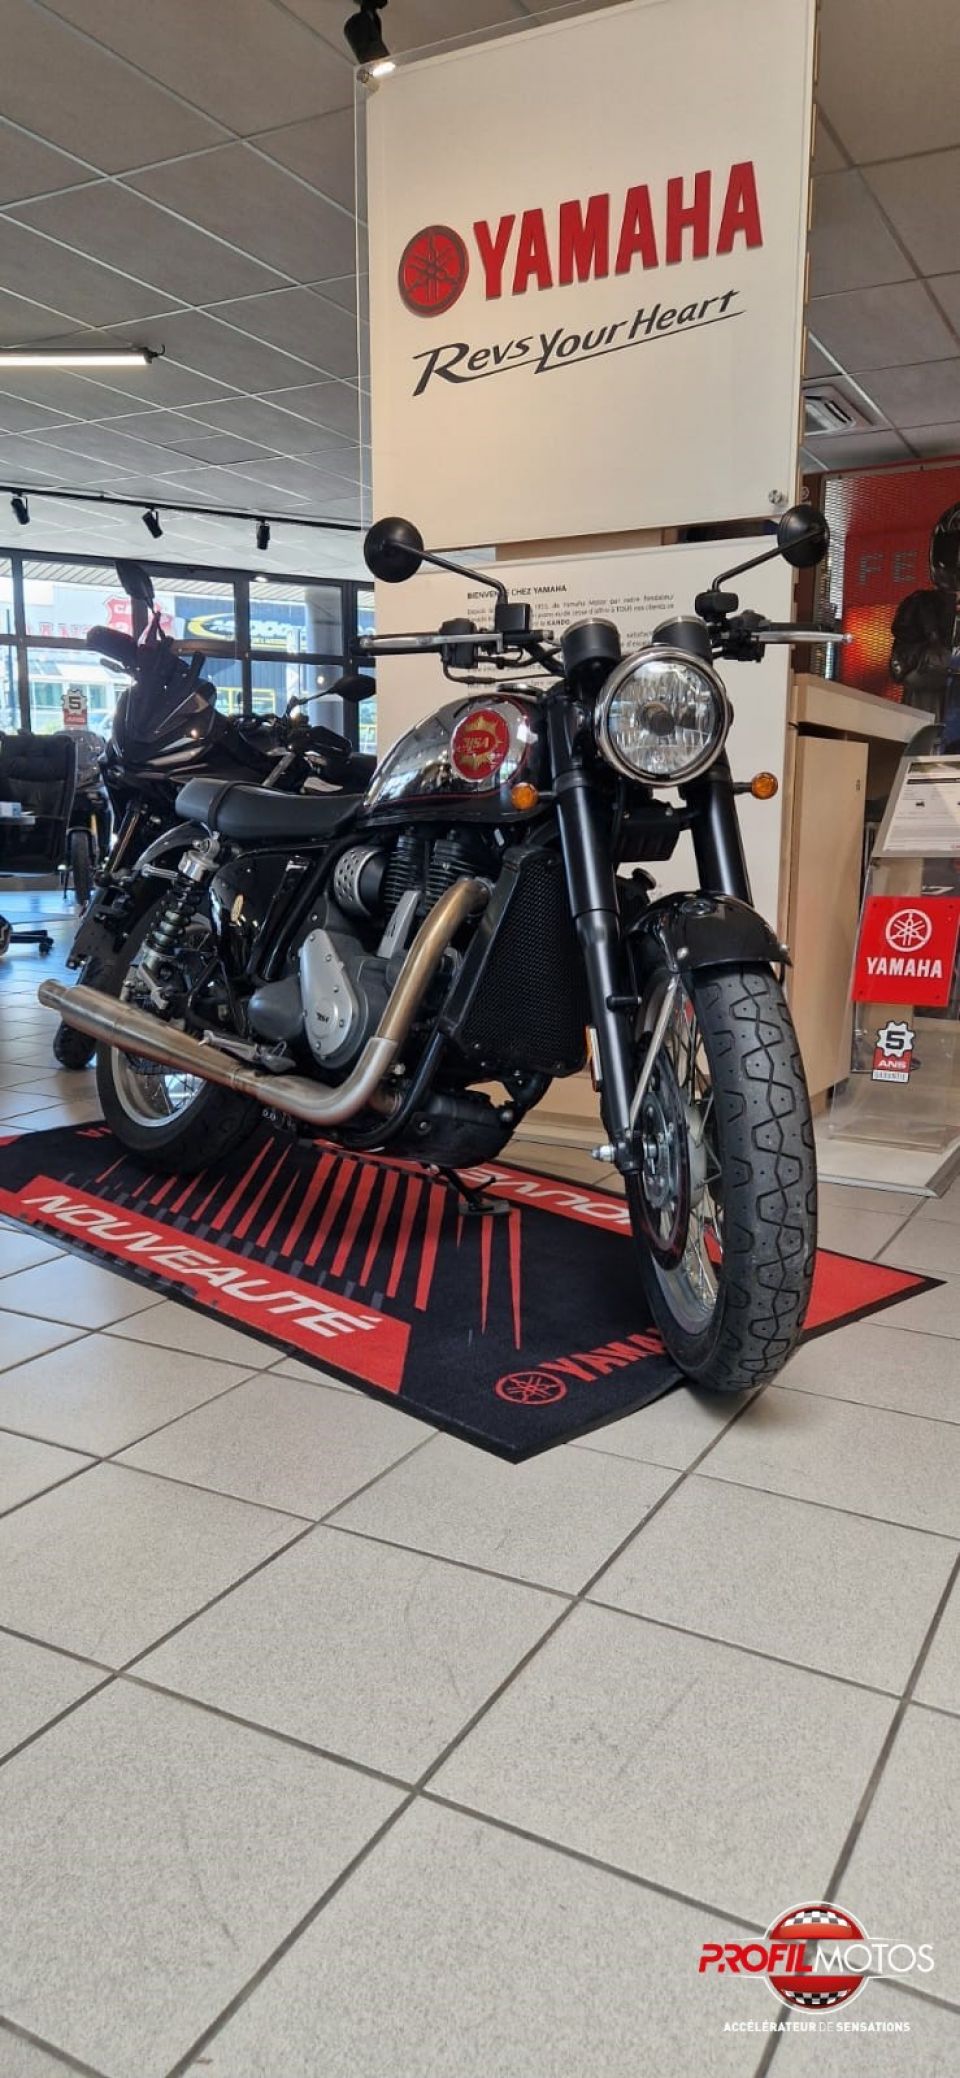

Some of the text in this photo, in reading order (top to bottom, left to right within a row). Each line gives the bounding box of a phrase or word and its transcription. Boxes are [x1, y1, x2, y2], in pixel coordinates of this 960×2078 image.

[473, 160, 763, 300] YAMAHA
[412, 288, 742, 397] Revs Your Heart
[512, 587, 531, 596] CHEZ
[533, 584, 567, 594] YAMAHA
[68, 695, 82, 709] 5
[866, 956, 943, 979] YAMAHA
[885, 1030, 905, 1050] 5
[878, 1059, 908, 1069] ANS
[20, 1195, 382, 1338] NOUVEAUTÉ
[539, 1328, 668, 1382] YAMA
